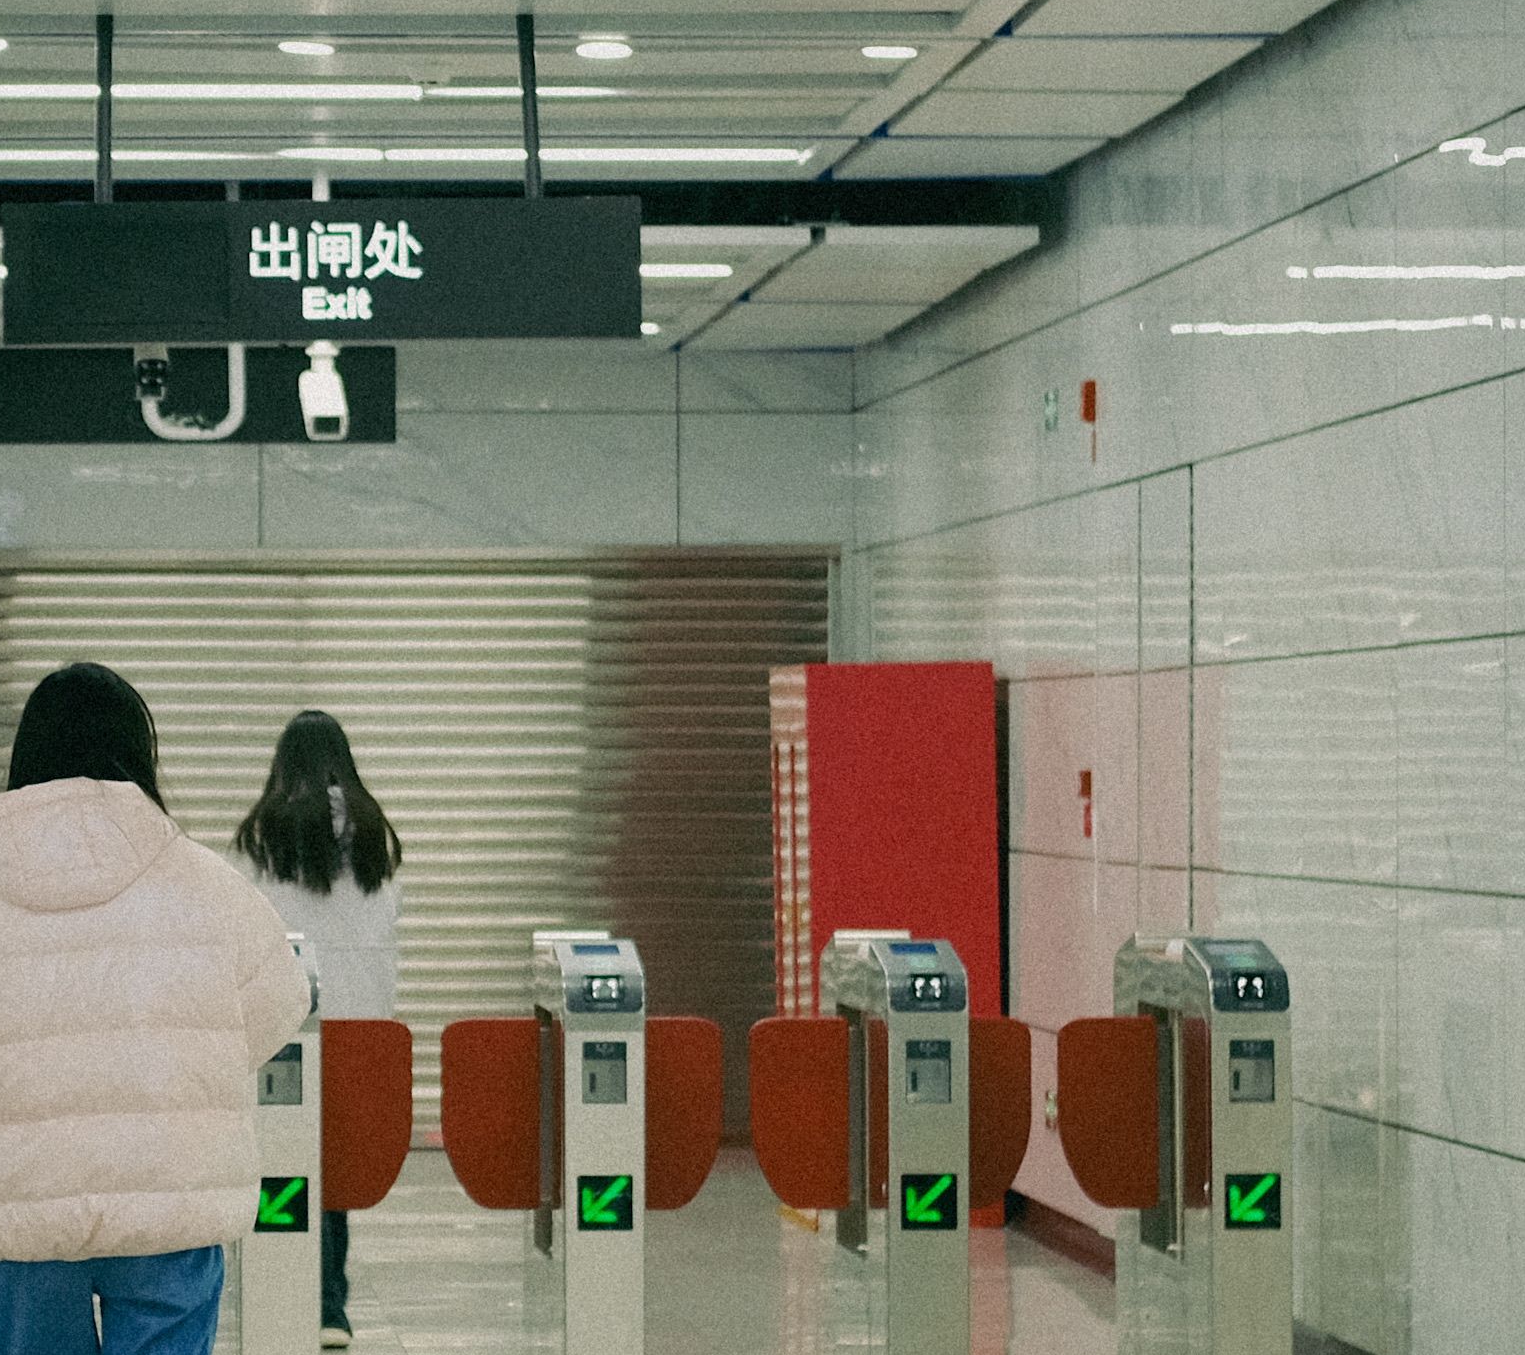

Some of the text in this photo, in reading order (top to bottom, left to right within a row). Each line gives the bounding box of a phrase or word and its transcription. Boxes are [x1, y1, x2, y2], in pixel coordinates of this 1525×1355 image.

[248, 219, 424, 283] 出闸处
[300, 286, 374, 322] Exit
